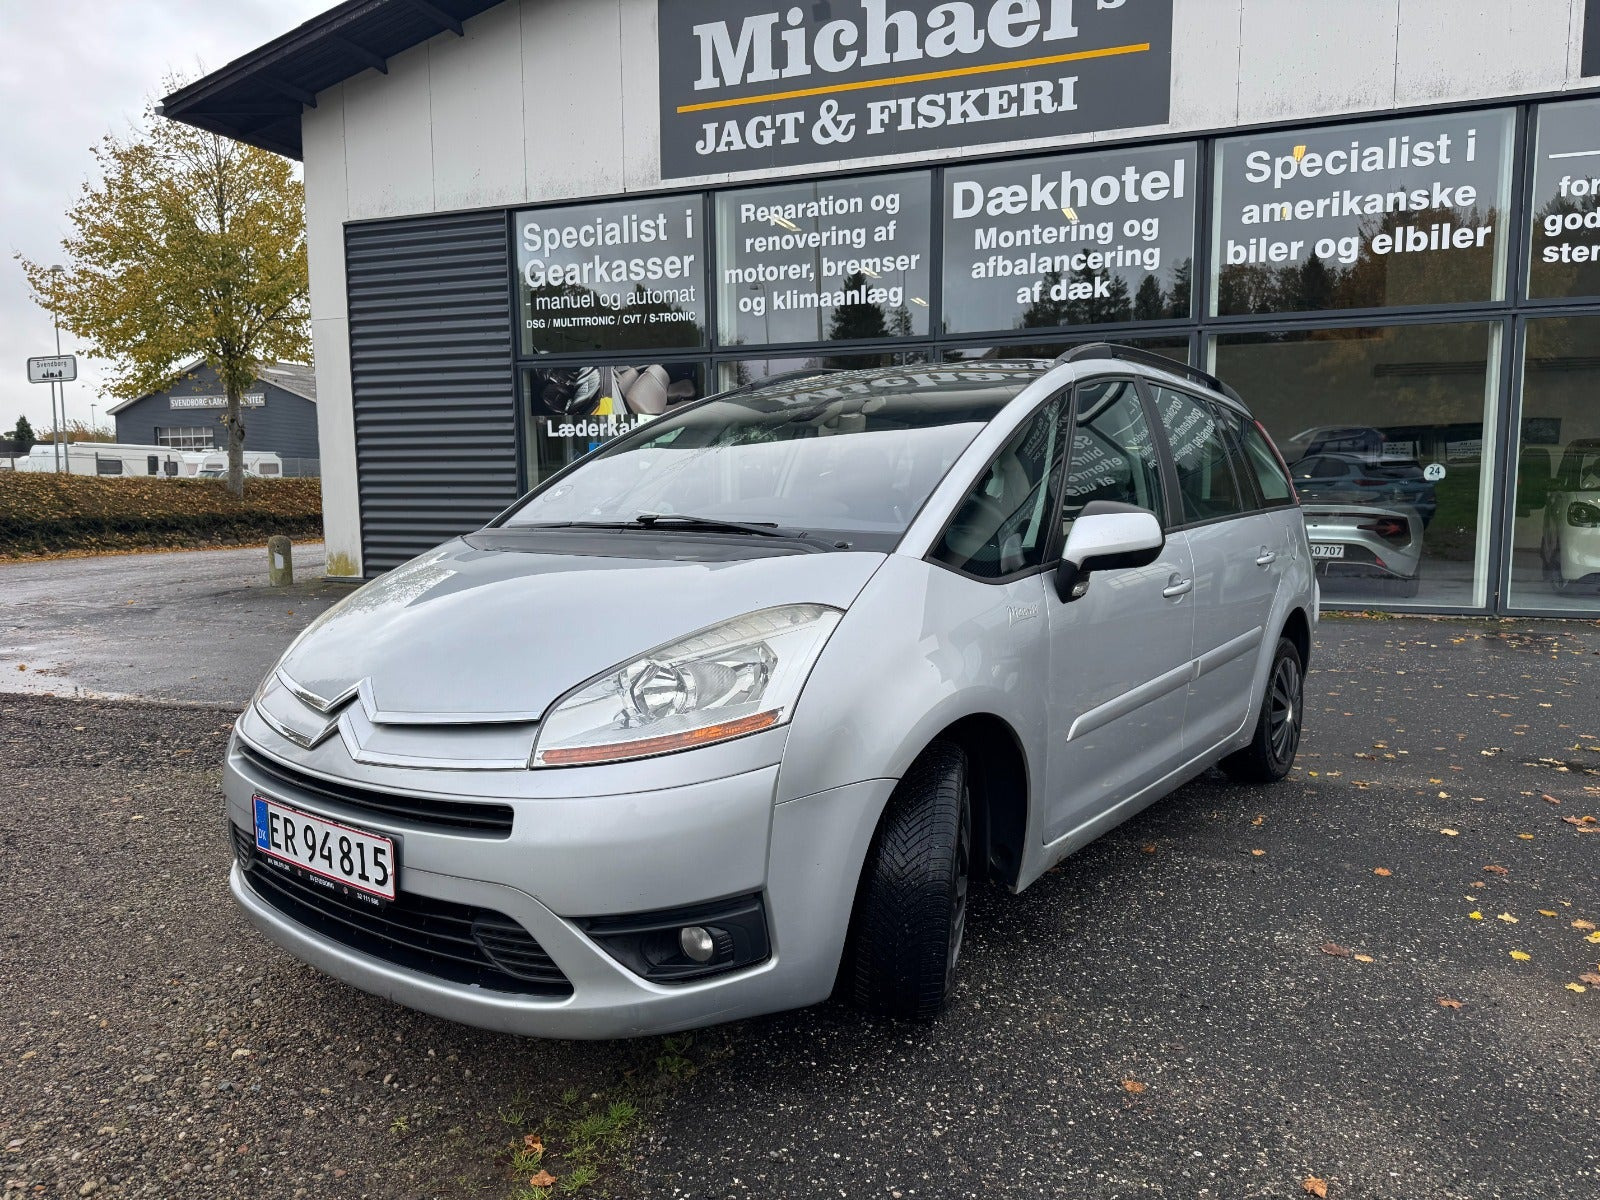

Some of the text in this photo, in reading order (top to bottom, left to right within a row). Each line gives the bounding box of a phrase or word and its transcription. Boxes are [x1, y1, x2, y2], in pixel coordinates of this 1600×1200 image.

[693, 0, 1127, 91] Michael
[695, 76, 1079, 155] JAGT & FISKERI
[1245, 129, 1477, 189] Specialist i
[952, 158, 1185, 219] Dækhotel
[1241, 182, 1477, 225] amerikanske
[740, 192, 900, 226] Reparation og
[523, 209, 694, 256] Specialist i
[745, 220, 897, 253] renovering af
[974, 217, 1159, 250] Montering og
[1226, 222, 1492, 265] biler og elbiler
[524, 254, 696, 288] Gearkasser
[724, 253, 921, 285] motorer, bremser
[971, 244, 1161, 279] afbalancering
[536, 290, 595, 310] manuel
[600, 293, 621, 311] og
[626, 285, 696, 305] automat
[738, 284, 903, 317] og klimaanlæg
[1016, 276, 1111, 304] af dæk
[526, 319, 546, 329] DSG
[552, 315, 615, 328] MULTITRONIC
[623, 314, 642, 325] CVT
[649, 311, 696, 323] S-TRONIC
[36, 360, 67, 369] Svendborg
[170, 398, 208, 408] SVENDBORG
[1429, 466, 1441, 476] 24
[1323, 546, 1342, 556] 707
[268, 811, 298, 857] ER
